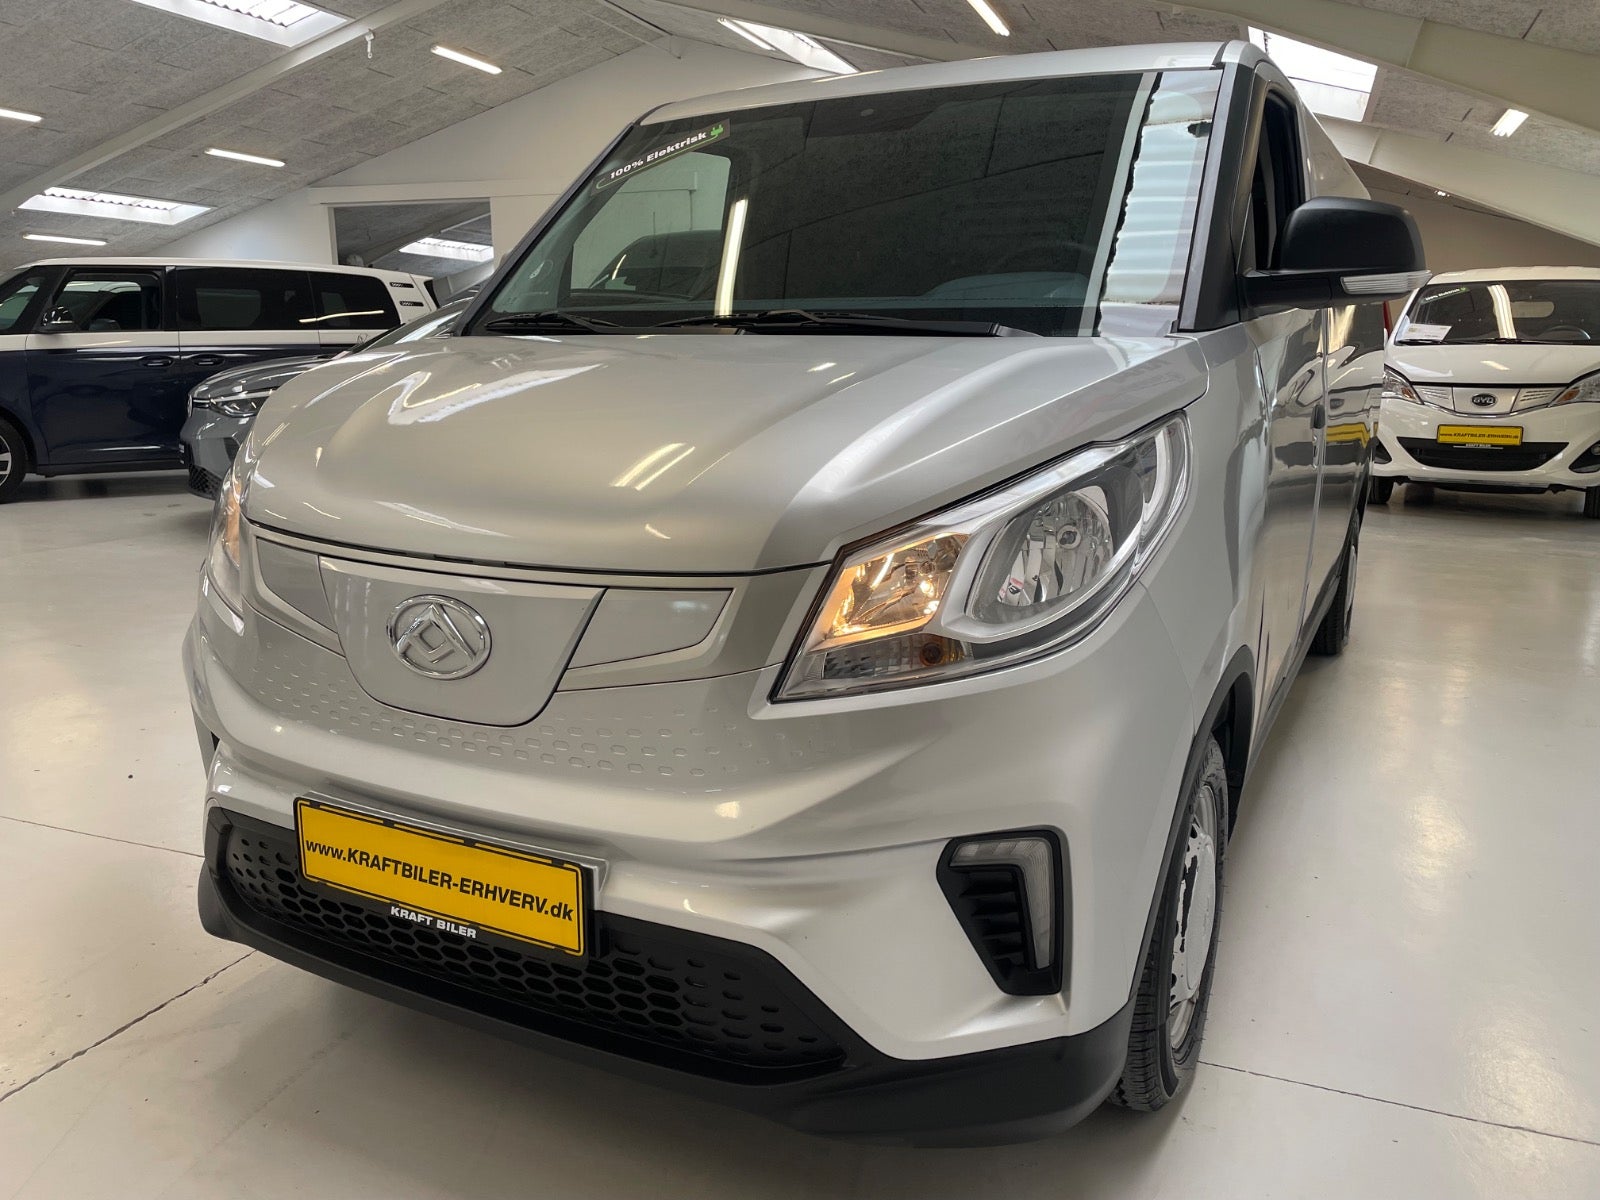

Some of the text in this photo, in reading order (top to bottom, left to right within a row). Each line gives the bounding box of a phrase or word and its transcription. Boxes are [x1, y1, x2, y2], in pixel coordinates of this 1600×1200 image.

[609, 131, 707, 179] 100% Elektrisk
[305, 839, 574, 922] www.KRAFTBILER-ERHVERV.dk
[390, 905, 477, 939] KRAFT BILER
